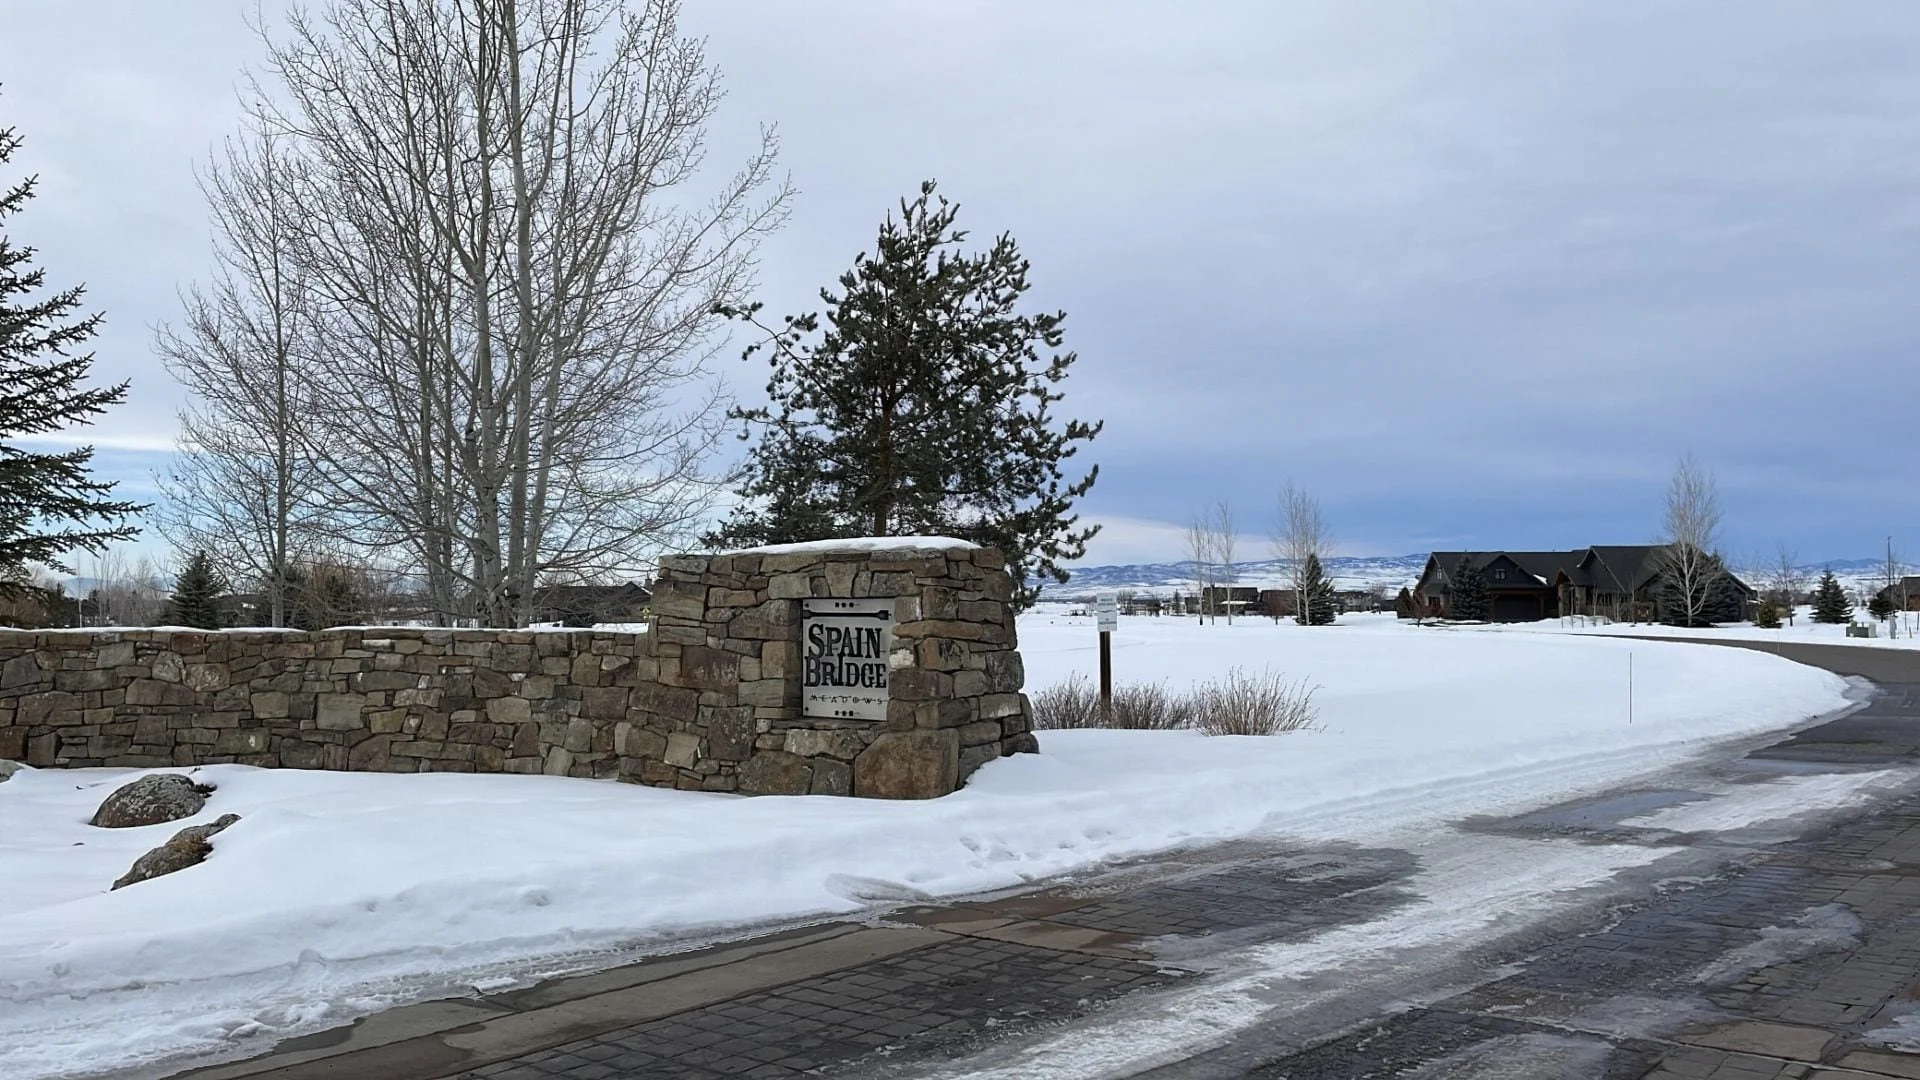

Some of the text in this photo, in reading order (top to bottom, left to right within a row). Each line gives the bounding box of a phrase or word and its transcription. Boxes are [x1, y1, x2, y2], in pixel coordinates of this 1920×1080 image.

[808, 623, 882, 658] SPAIN
[804, 654, 886, 688] BRIDGE
[809, 695, 883, 705] MEADOWS
